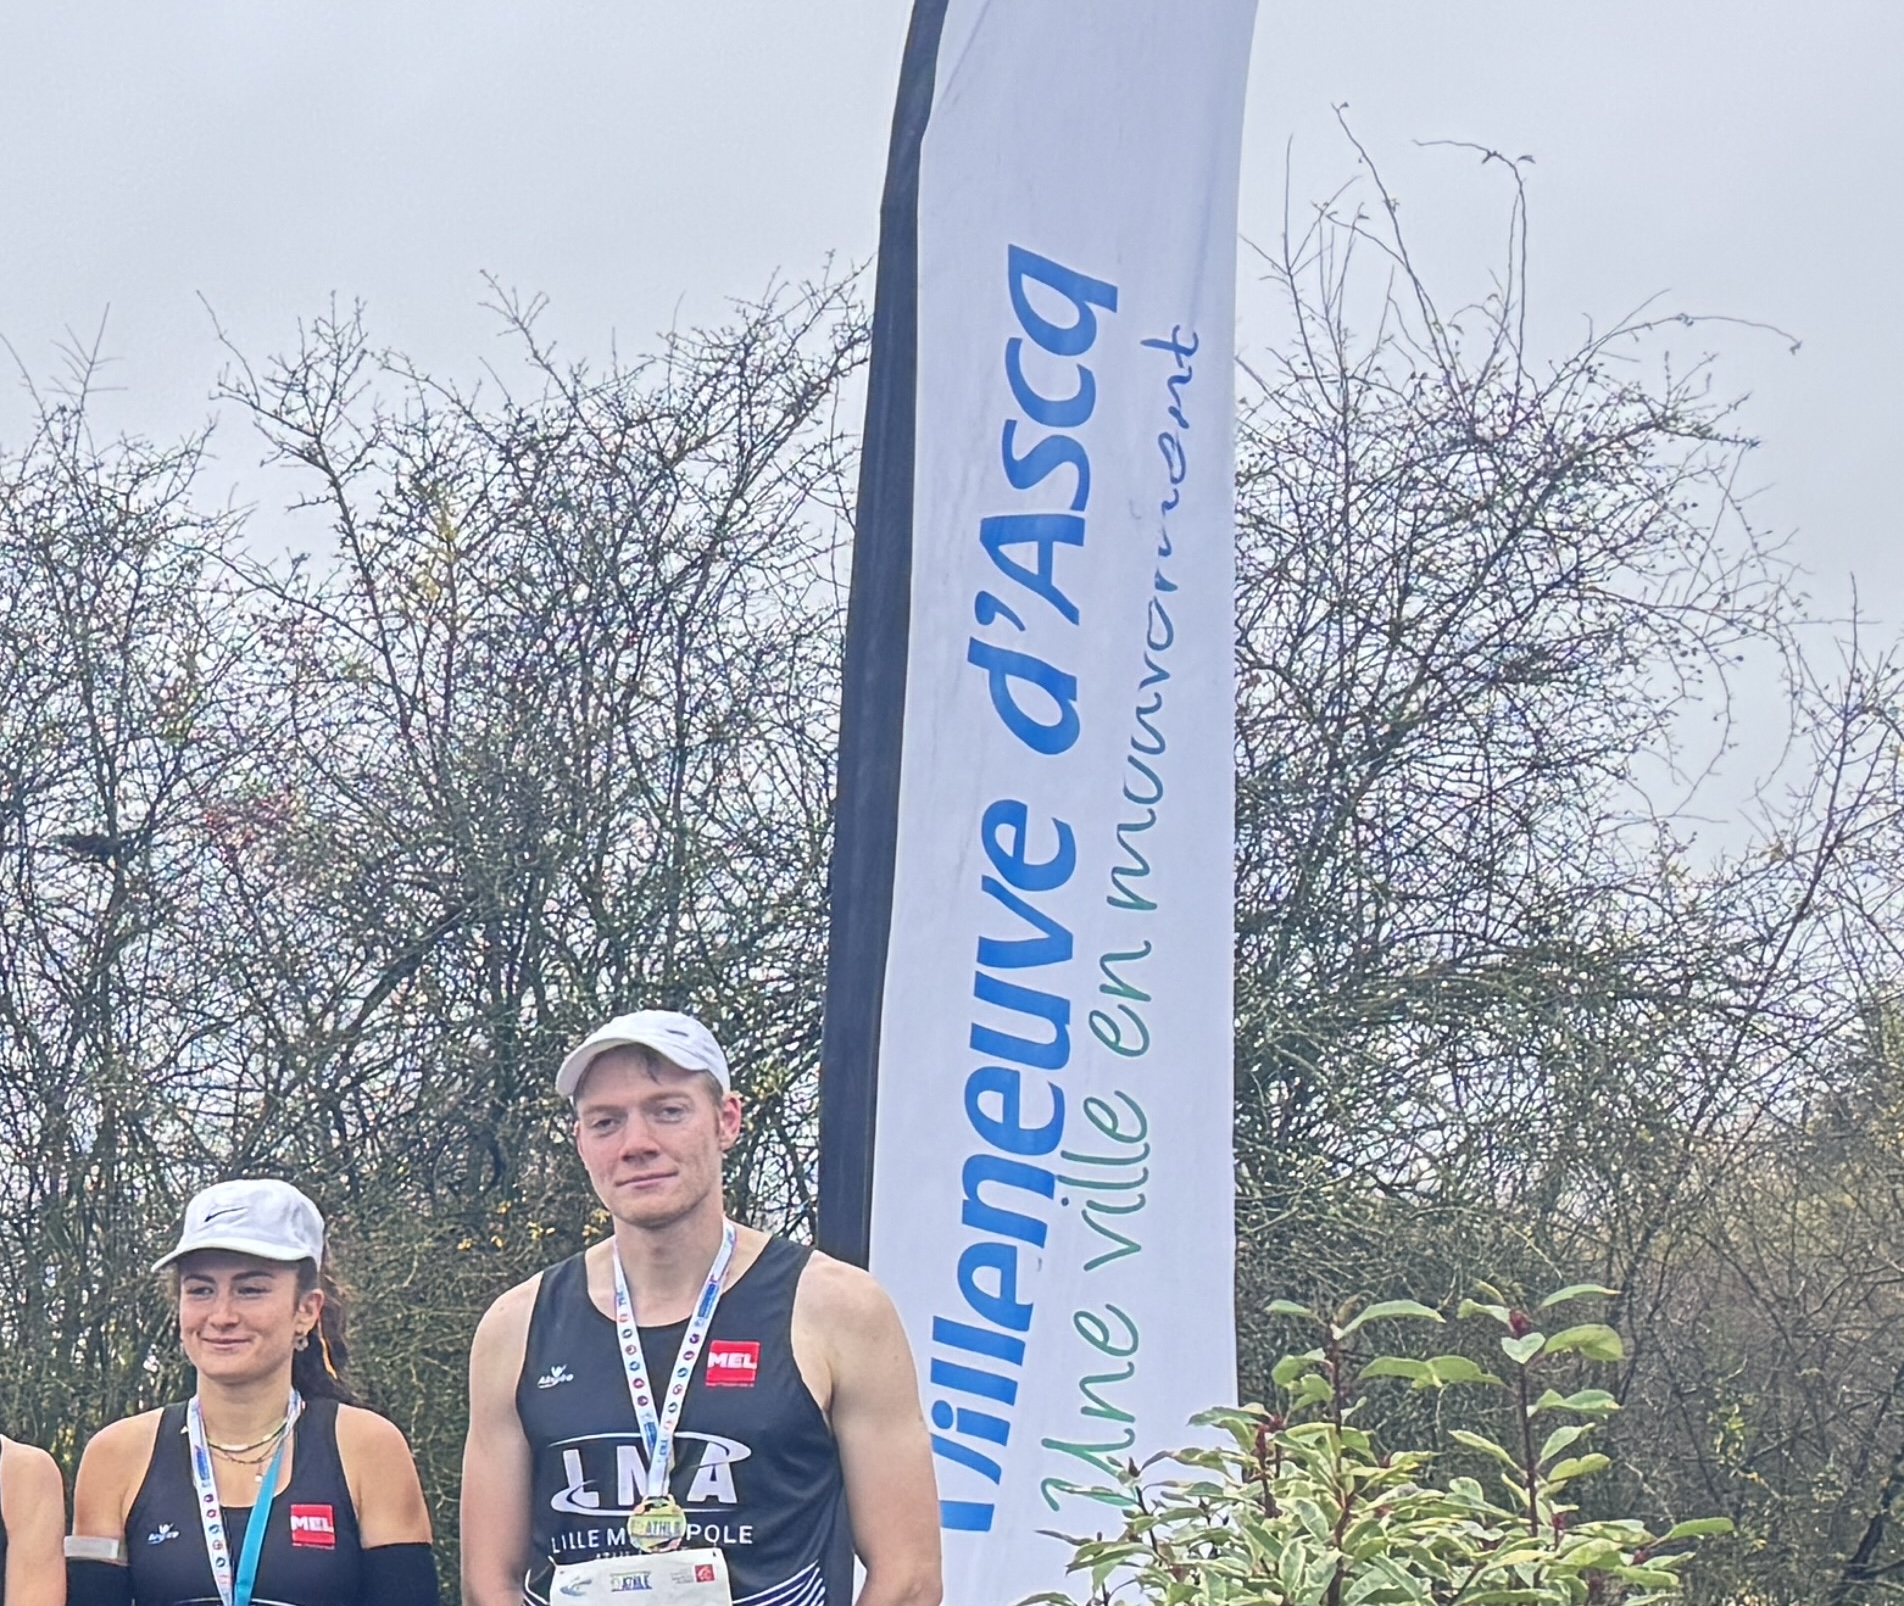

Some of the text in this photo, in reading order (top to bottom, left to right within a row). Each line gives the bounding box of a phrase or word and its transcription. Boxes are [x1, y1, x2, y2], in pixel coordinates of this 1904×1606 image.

[933, 244, 1119, 1532] Villeneuve d'Ascq
[1088, 941, 1153, 1058] en
[1057, 1091, 1151, 1272] ville
[709, 1351, 758, 1371] MEL
[1040, 1304, 1140, 1513] Une
[291, 1516, 335, 1533] MEL
[551, 1529, 600, 1554] LILLE
[607, 1524, 754, 1550] MPOLE
